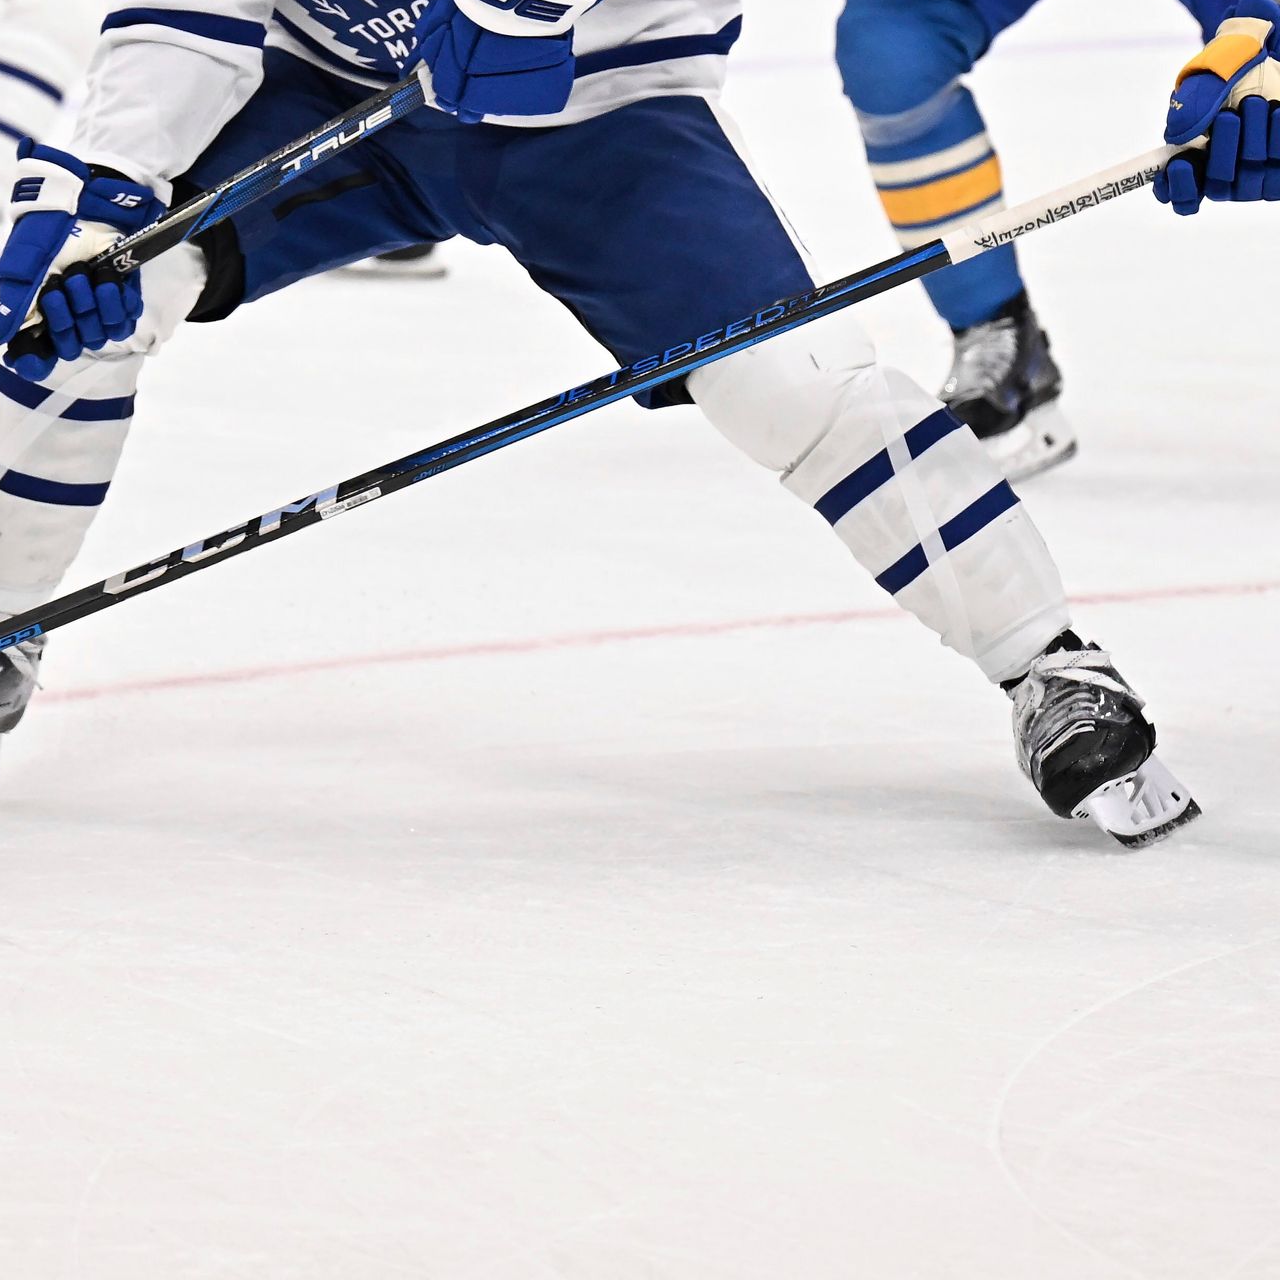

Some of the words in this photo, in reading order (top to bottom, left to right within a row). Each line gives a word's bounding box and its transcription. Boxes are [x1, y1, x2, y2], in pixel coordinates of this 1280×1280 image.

[281, 105, 394, 172] TRUE
[110, 192, 142, 208] 16
[538, 304, 785, 414] JETSPEED
[104, 485, 341, 596] CCM
